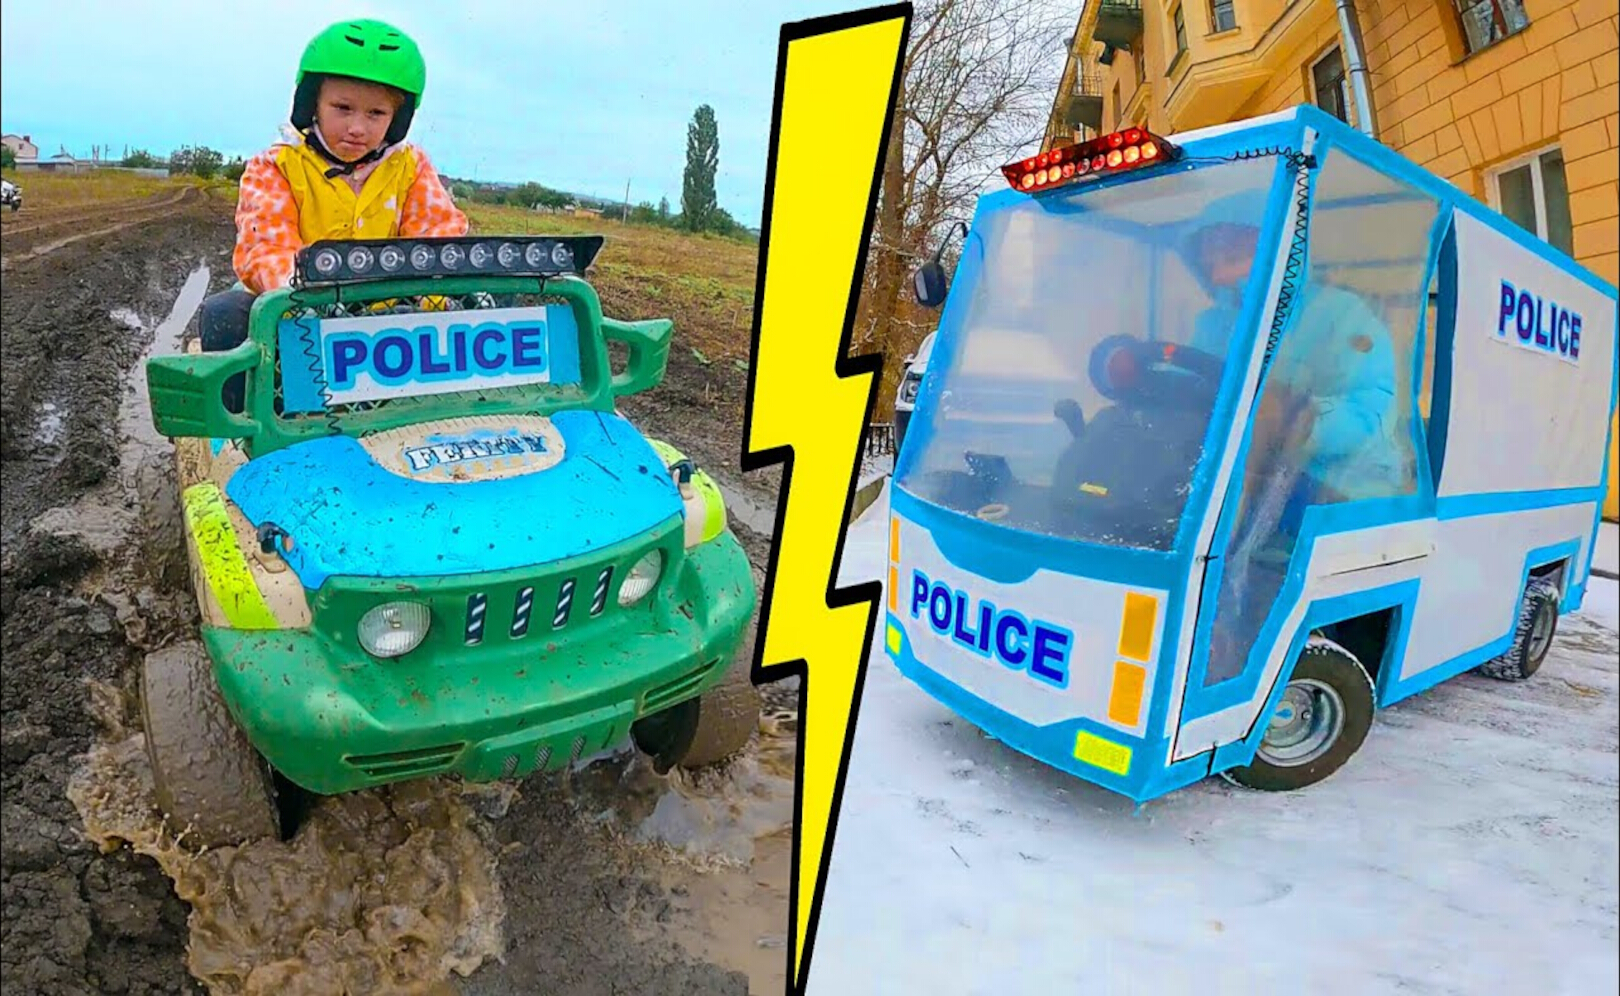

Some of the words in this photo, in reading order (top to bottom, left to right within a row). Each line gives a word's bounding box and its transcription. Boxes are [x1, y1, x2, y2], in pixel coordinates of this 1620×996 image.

[332, 327, 541, 383] POLICE
[1498, 282, 1581, 357] POLICE
[912, 573, 1068, 683] POLICE
